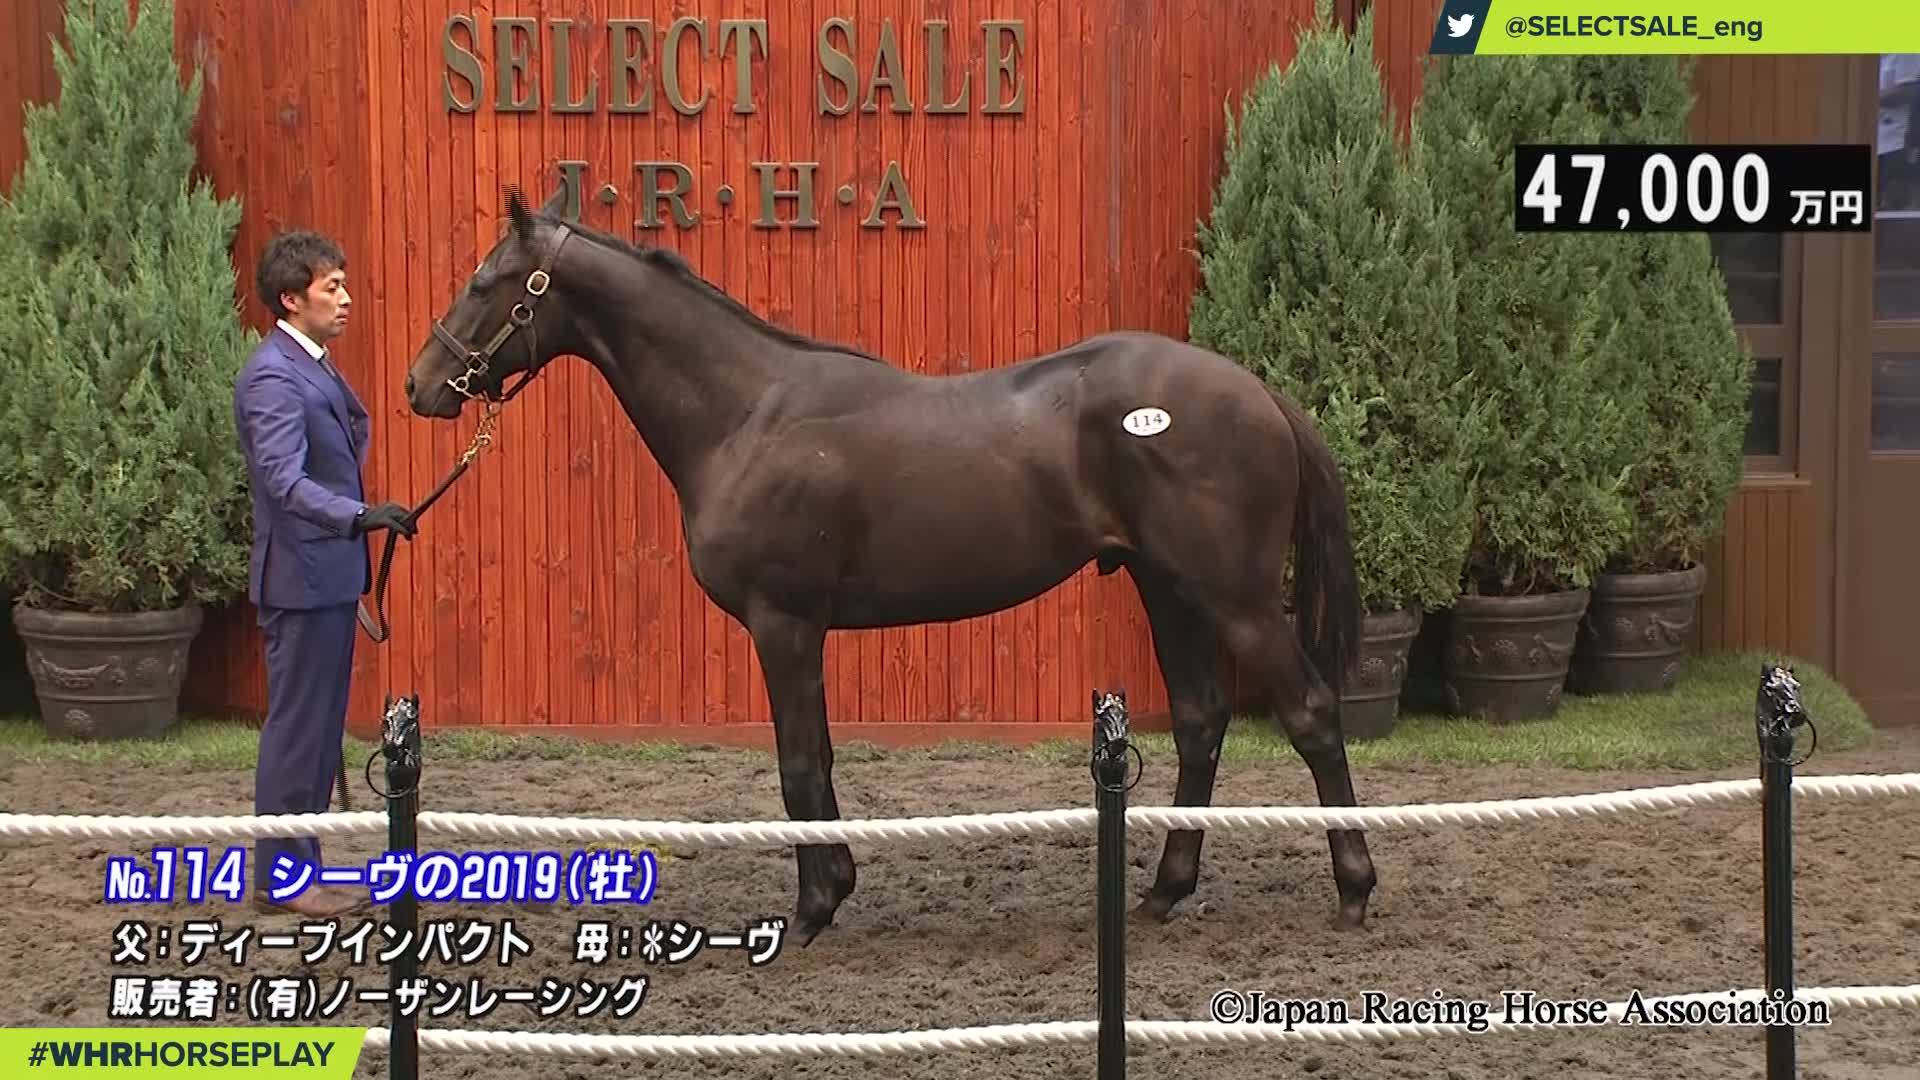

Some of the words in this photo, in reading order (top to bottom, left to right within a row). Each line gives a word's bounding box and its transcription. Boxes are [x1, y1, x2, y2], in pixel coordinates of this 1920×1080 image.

[441, 15, 768, 115] SELECT
[817, 16, 1026, 115] SALE
[1133, 413, 1163, 428] 114
